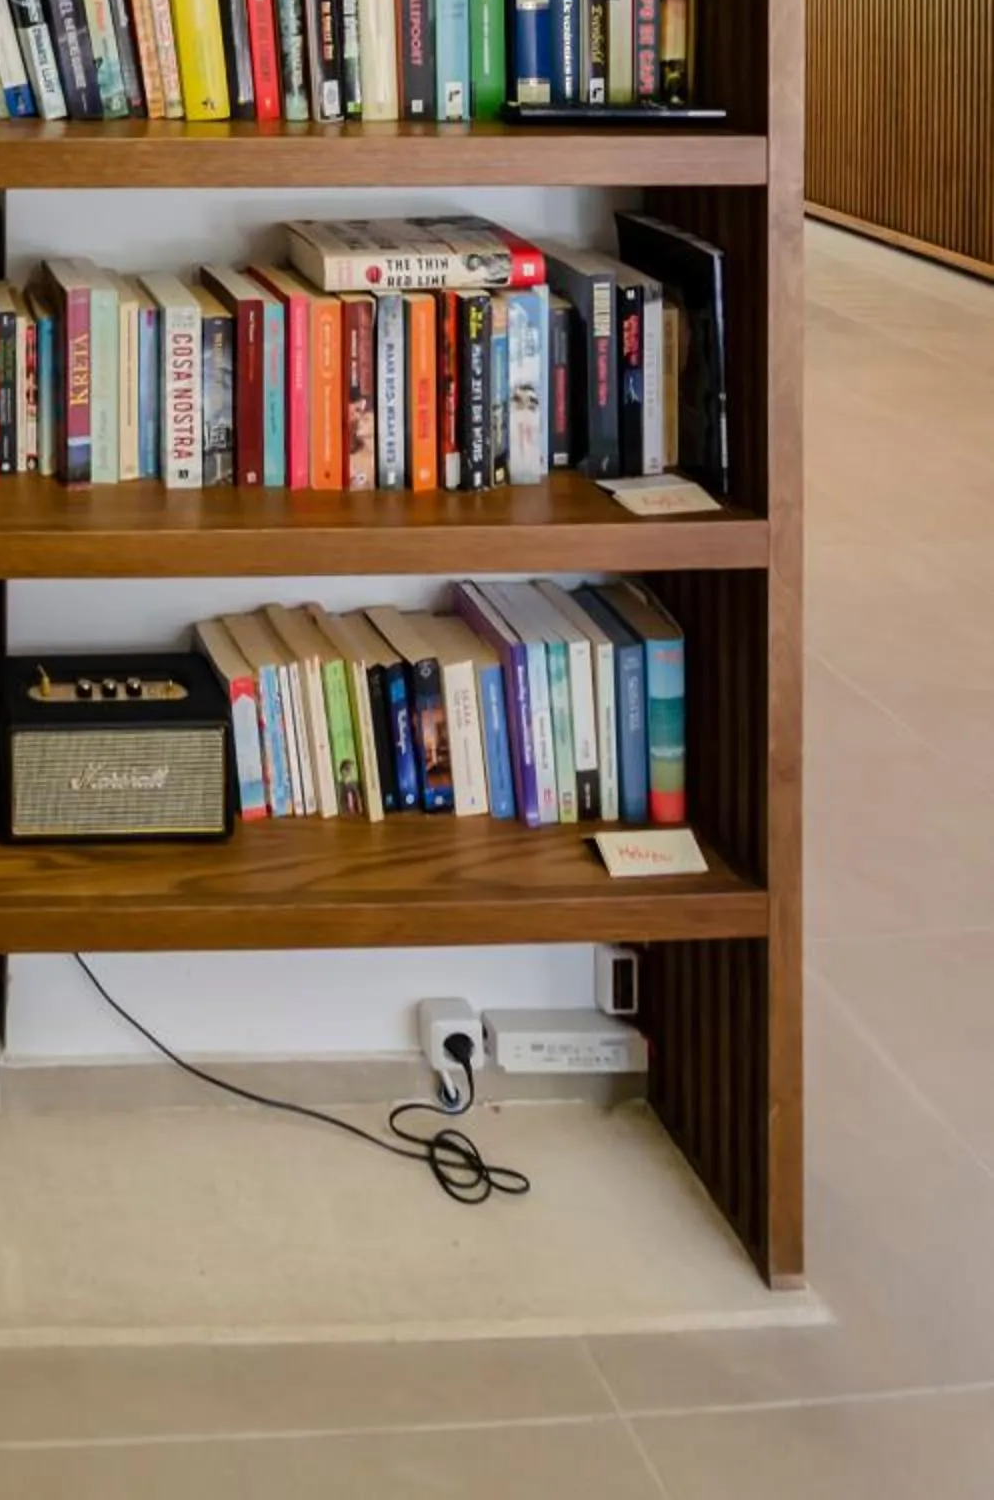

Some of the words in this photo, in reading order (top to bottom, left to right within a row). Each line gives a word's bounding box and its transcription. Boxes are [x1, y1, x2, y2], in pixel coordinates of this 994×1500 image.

[386, 258, 411, 270] THE
[417, 257, 449, 270] THIN
[386, 275, 413, 287] RED
[418, 274, 447, 286] LINE
[69, 333, 88, 405] KRETA
[172, 333, 193, 380] COSA
[172, 388, 193, 459] NOSTRA
